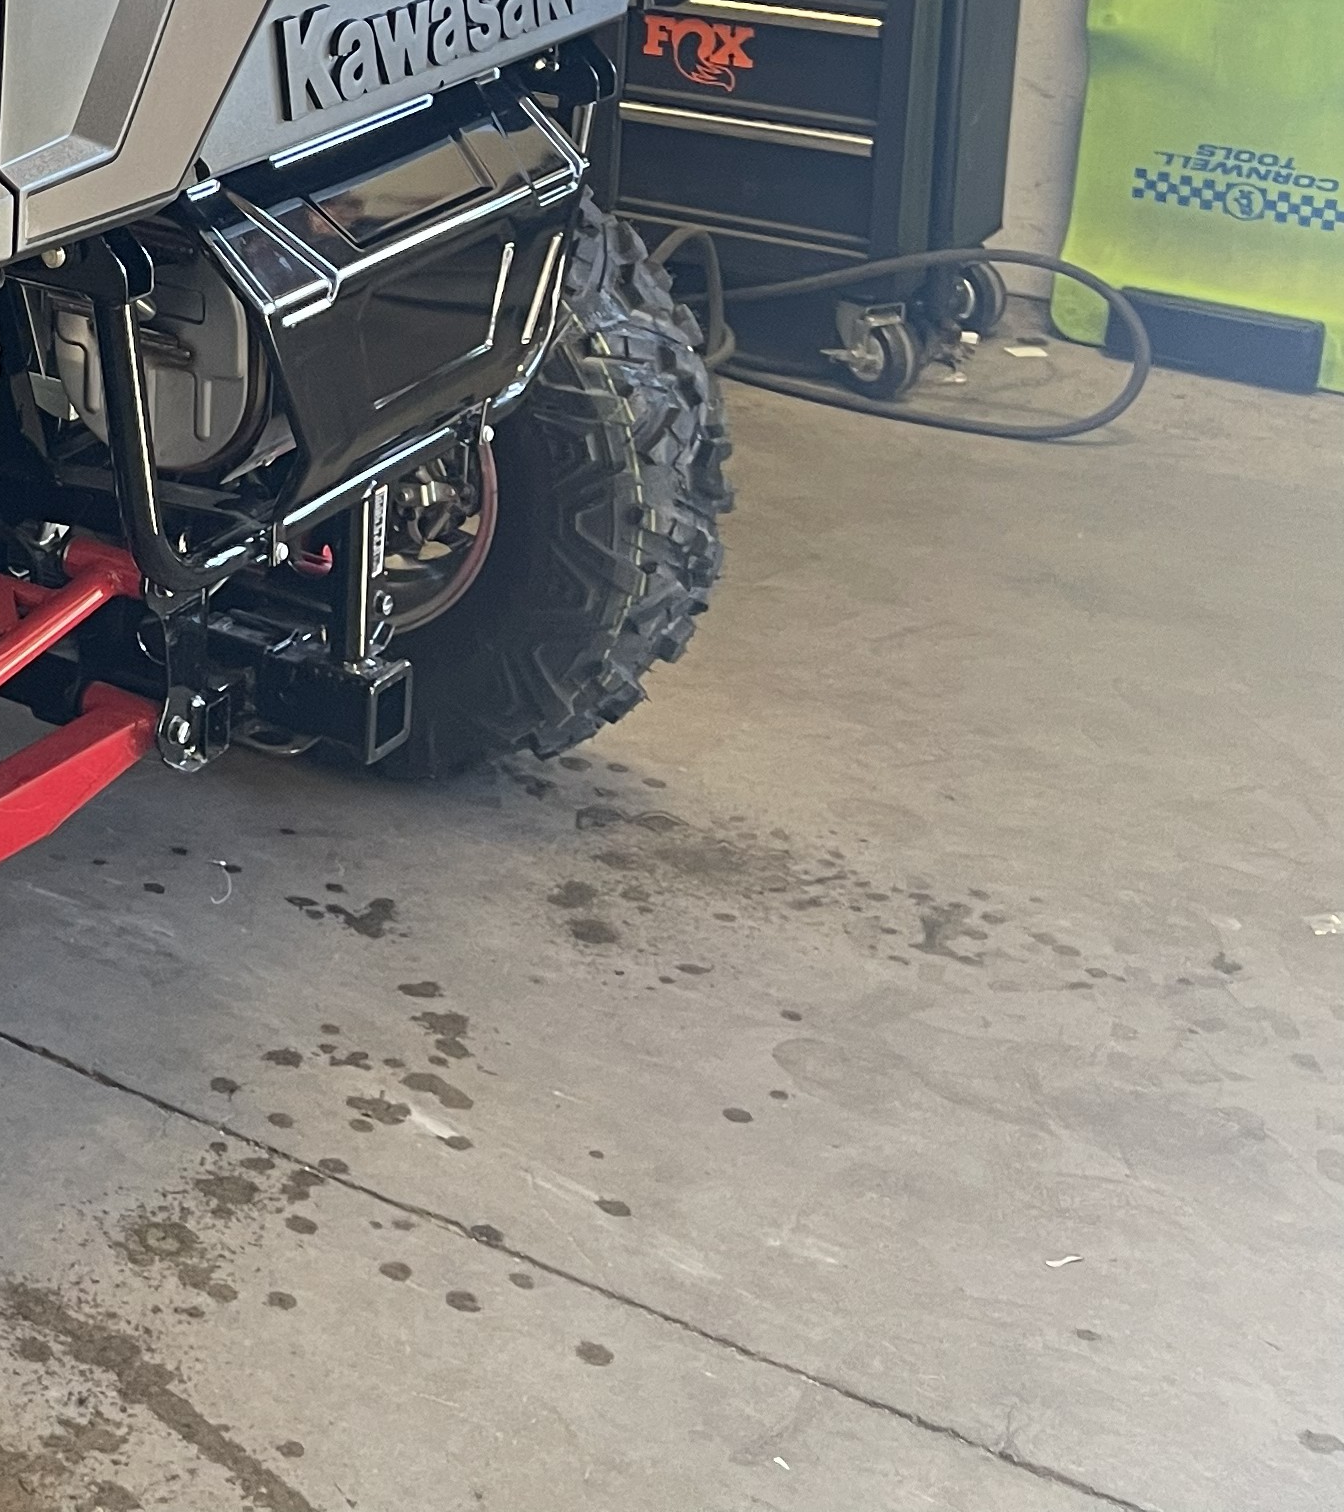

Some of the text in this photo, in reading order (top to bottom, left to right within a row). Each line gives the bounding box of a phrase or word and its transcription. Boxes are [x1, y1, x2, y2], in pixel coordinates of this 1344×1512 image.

[643, 14, 755, 91] FOX
[1154, 150, 1340, 193] CORNWELL
[1196, 143, 1296, 171] TOOLS
